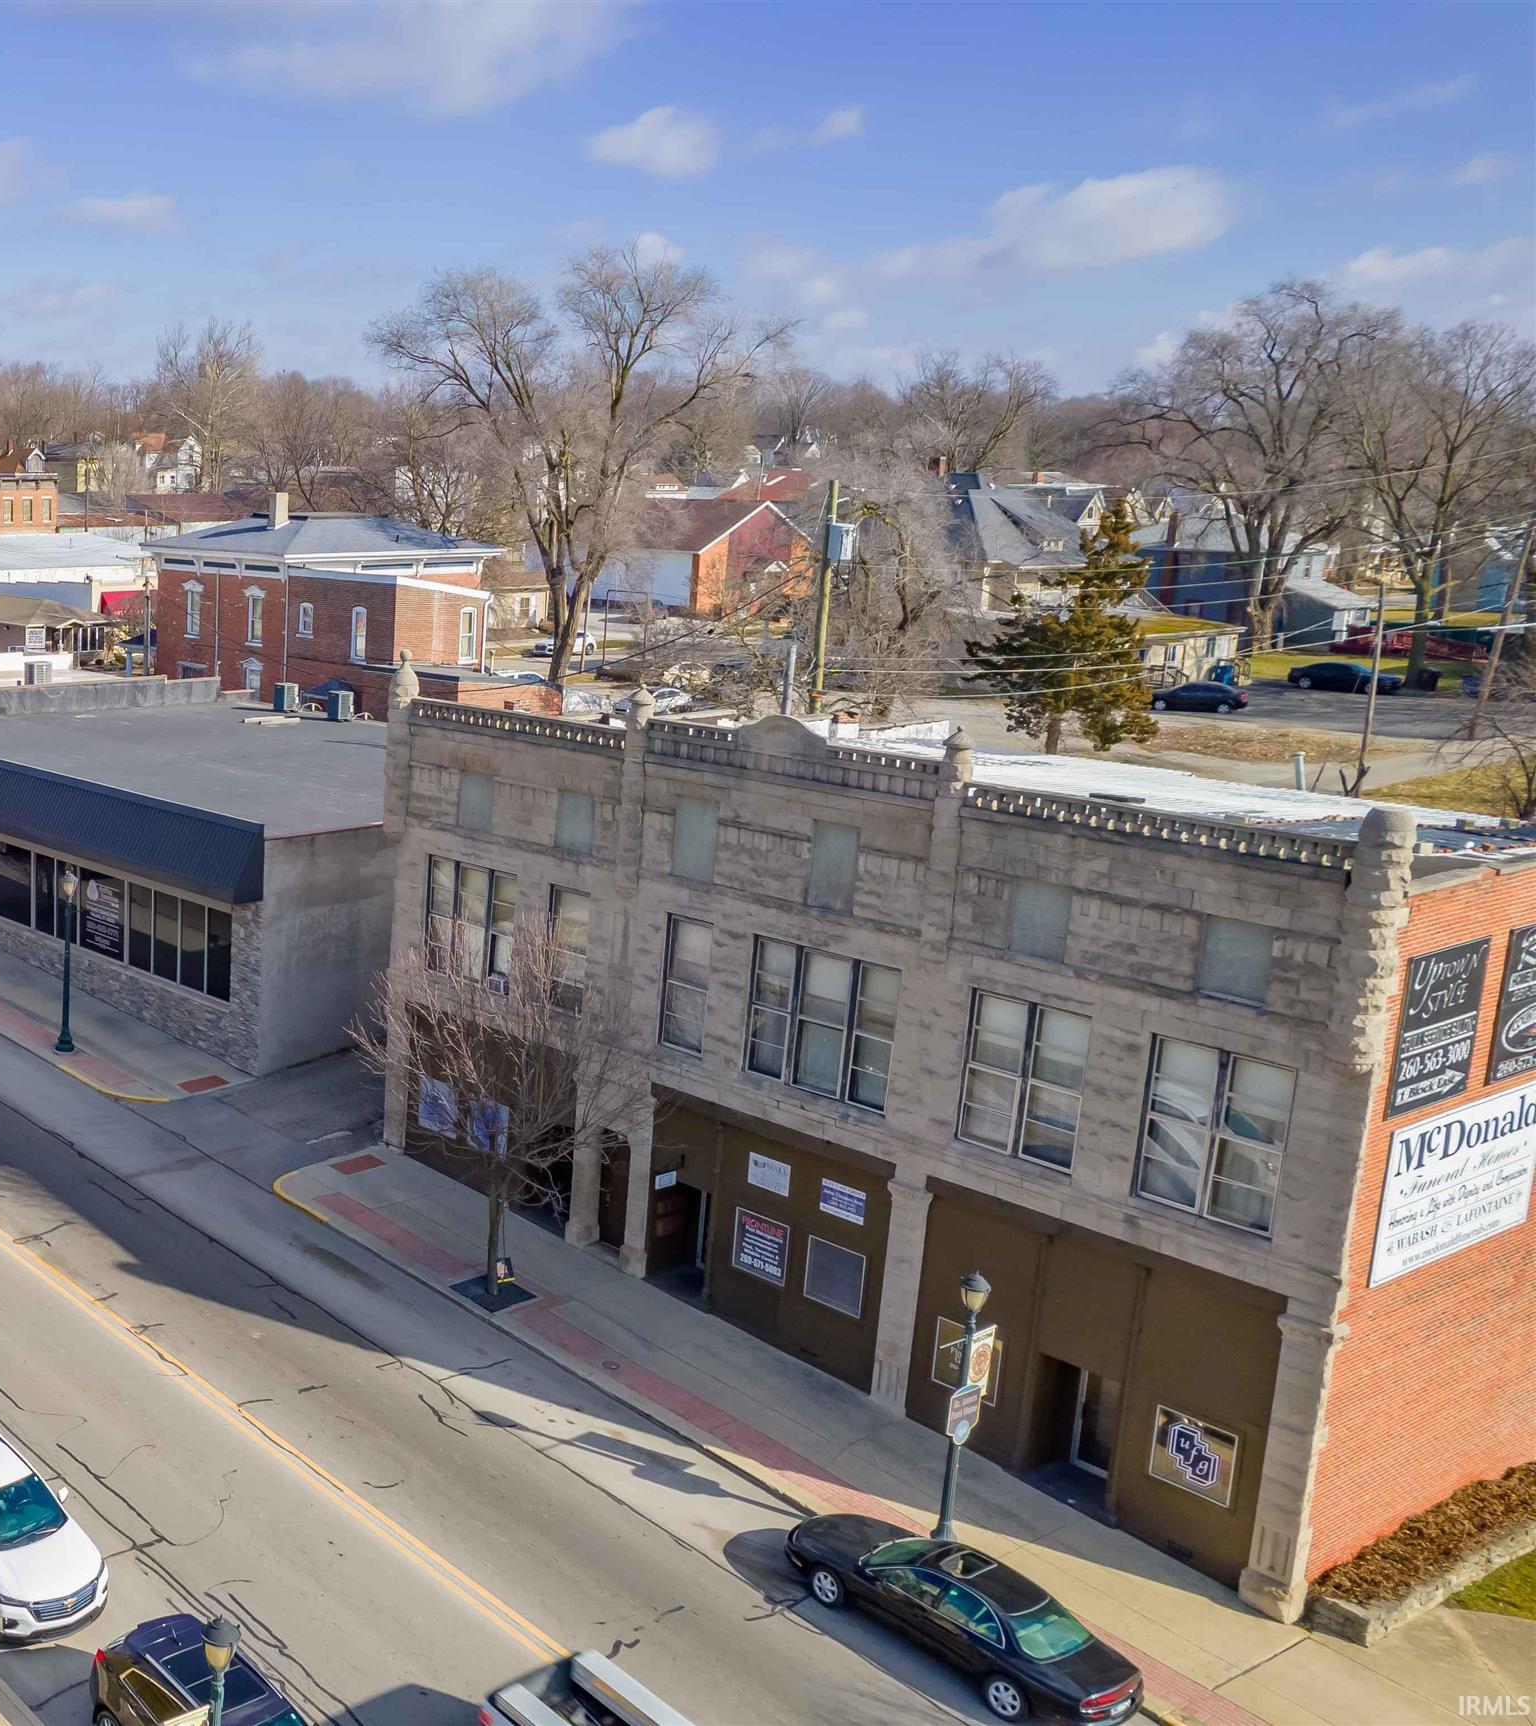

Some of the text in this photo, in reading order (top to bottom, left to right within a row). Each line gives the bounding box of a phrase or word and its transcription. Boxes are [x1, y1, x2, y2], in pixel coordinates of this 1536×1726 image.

[1421, 980, 1469, 1018] STYLE
[1398, 1040, 1470, 1081] 260-563-3000
[1408, 1080, 1433, 1098] Block
[1396, 1225, 1437, 1251] WABASH
